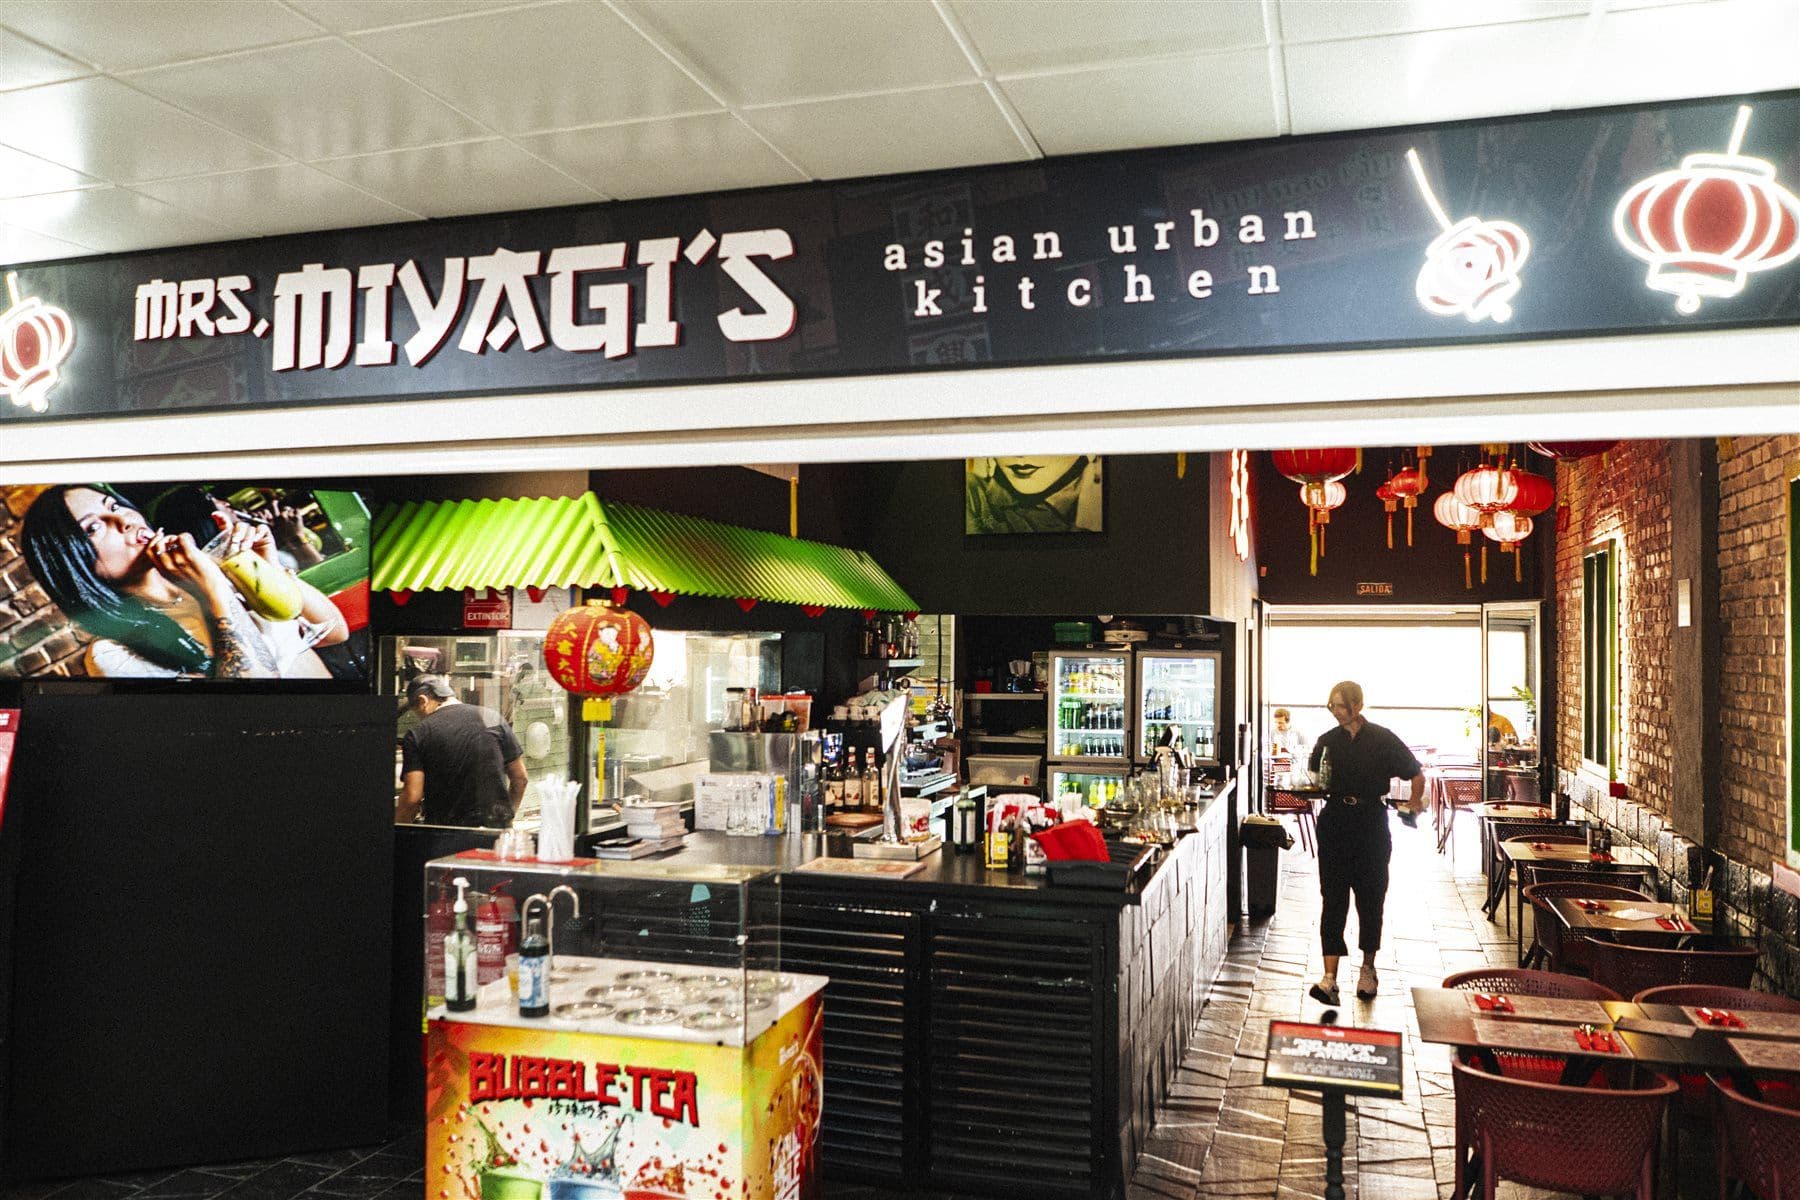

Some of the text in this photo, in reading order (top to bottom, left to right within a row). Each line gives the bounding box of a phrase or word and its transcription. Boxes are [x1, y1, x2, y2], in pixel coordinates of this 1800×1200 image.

[883, 208, 1317, 272] asian urban
[272, 228, 797, 373] MIYAGI'S
[914, 263, 1281, 317] kitchen
[1360, 584, 1391, 595] SALIDA
